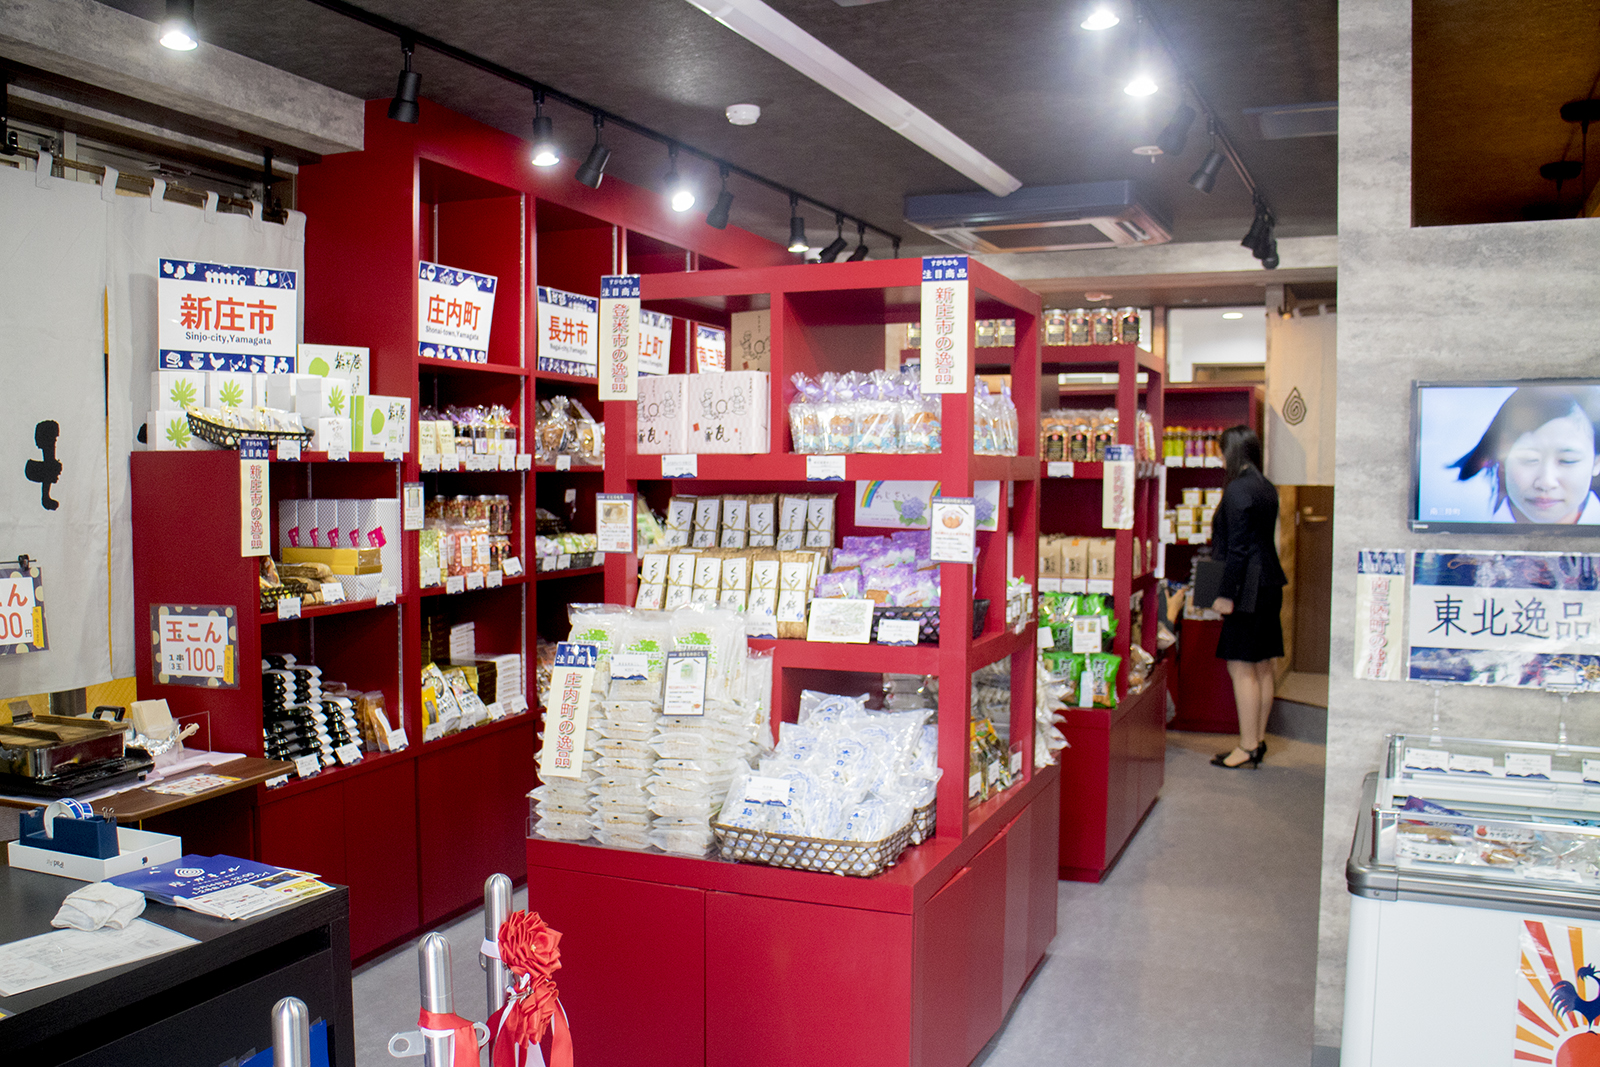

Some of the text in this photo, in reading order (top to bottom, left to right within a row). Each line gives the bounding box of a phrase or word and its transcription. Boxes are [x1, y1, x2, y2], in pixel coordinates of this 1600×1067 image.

[922, 268, 967, 279] 注目商品
[931, 259, 959, 267] すがもかも
[601, 287, 640, 297] 注目商品
[180, 293, 277, 334] 新庄市
[427, 294, 481, 331] 庄内町
[185, 331, 272, 346] Sinjo-city,Yamagata
[425, 325, 479, 341] Shonai-town,Yamagata
[548, 315, 589, 346] 長井市
[935, 287, 955, 385] 新庄市の逸品
[611, 303, 629, 393] 登米市の逸品
[240, 449, 269, 458] 注目商品
[250, 464, 264, 549] 新庄市の逸品
[0, 583, 28, 607] ん
[1428, 593, 1591, 641] 東北逸品
[166, 621, 222, 644] 玉こん
[556, 654, 597, 666] 注目商品
[554, 672, 583, 769] 庄内町の逸品
